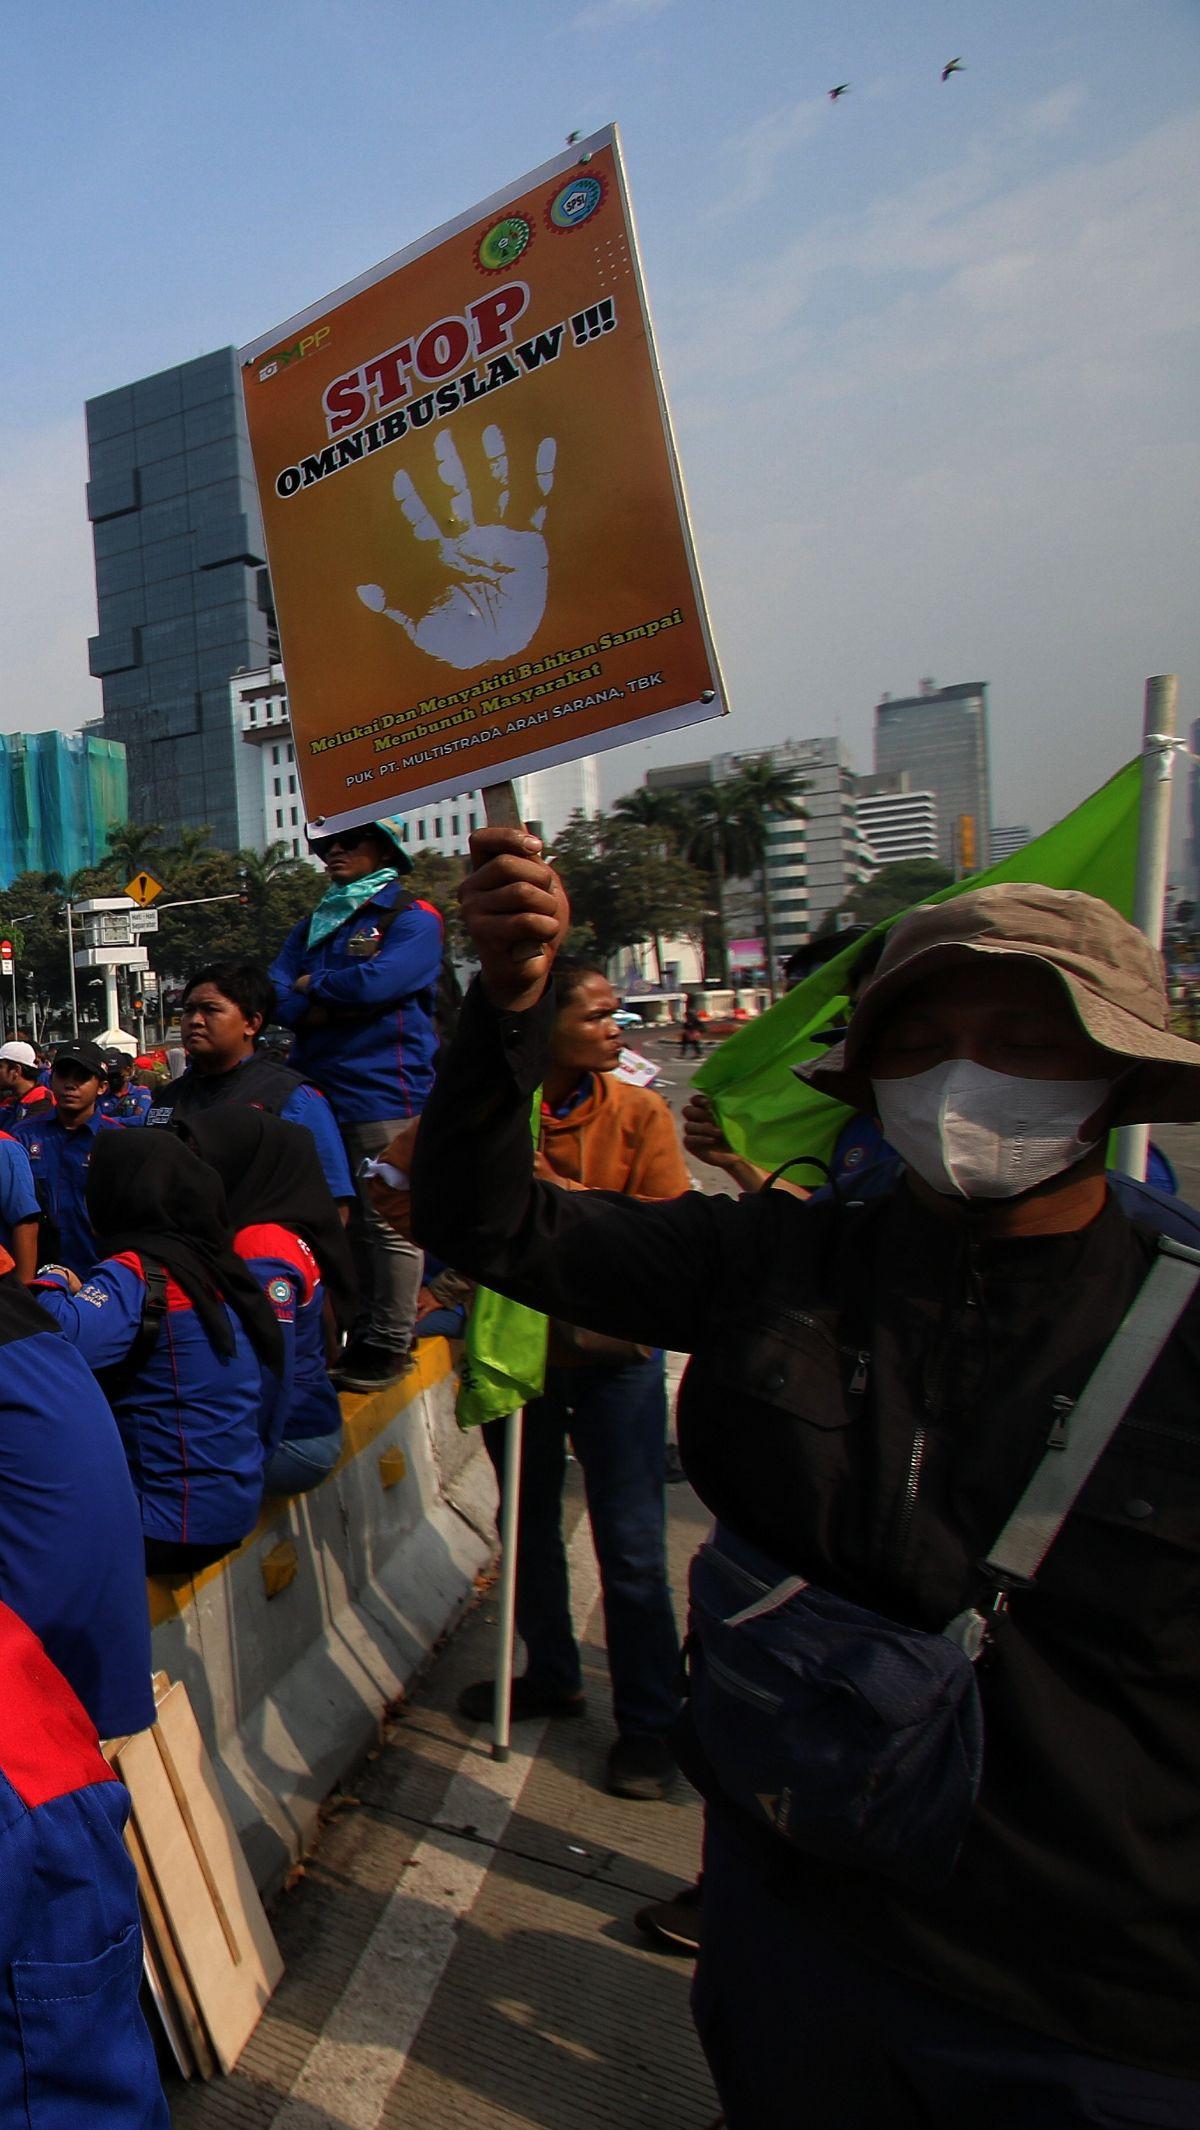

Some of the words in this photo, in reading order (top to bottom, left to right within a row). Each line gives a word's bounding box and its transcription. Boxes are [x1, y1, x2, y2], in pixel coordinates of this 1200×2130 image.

[564, 192, 587, 213] SPSI
[276, 324, 564, 499] OMNIBUSLAW
[570, 296, 617, 348] !!!
[323, 281, 531, 439] STOP
[310, 717, 382, 755] Melukai
[381, 709, 418, 730] Dan
[417, 668, 518, 717] Menyakiti
[517, 642, 598, 681] Bahkan
[599, 608, 684, 651] Sampai
[345, 768, 375, 788] PUK
[379, 762, 400, 777] PT.
[402, 725, 503, 768] MULTISTRADA
[505, 710, 549, 734] ARAH
[552, 687, 625, 719] SARANA,
[627, 672, 664, 693] TBK
[373, 706, 478, 753] Membunuh
[480, 660, 603, 716] Masyarakat
